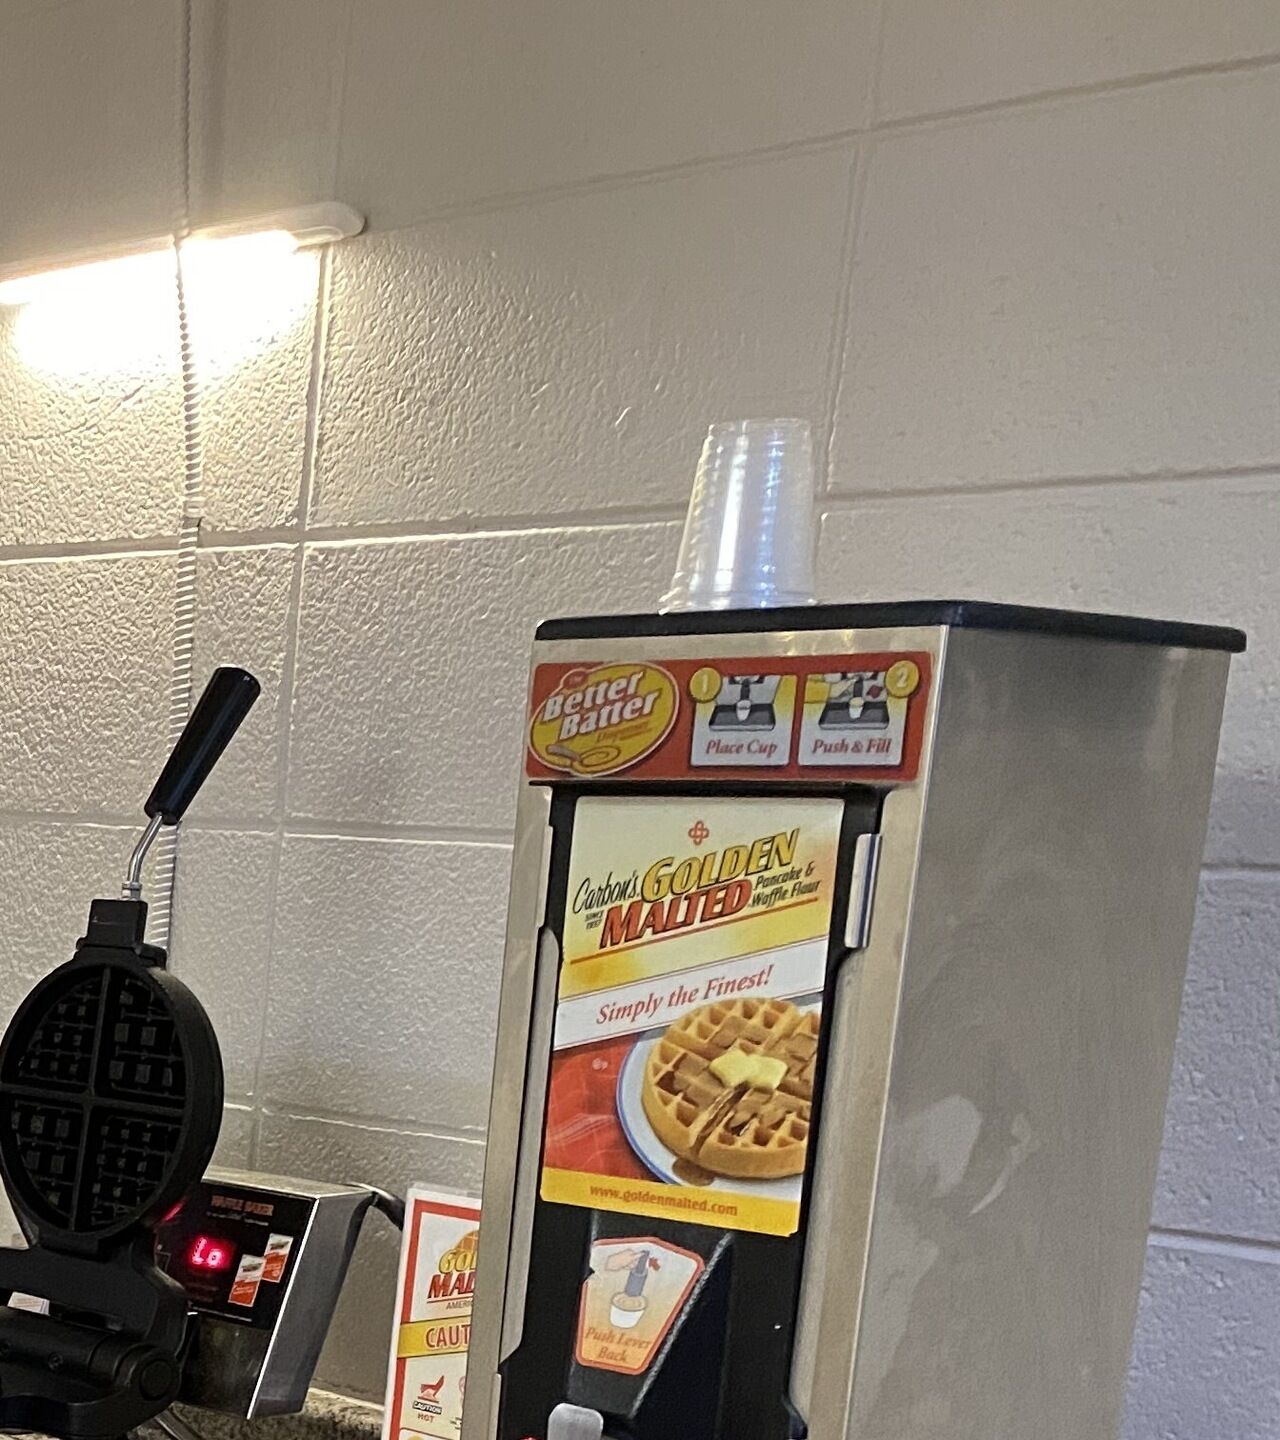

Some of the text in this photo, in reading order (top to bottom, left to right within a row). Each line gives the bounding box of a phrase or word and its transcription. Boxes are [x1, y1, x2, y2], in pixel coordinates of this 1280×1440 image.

[542, 671, 646, 722] Better
[559, 690, 661, 741] Batter
[706, 738, 778, 758] Place Cup
[811, 737, 892, 755] Push & Fill
[640, 828, 801, 903] GOLDEN
[755, 861, 816, 891] Pancake &
[572, 869, 640, 914] Carbon's
[752, 879, 823, 909] Waffle Flour
[598, 878, 754, 950] MALTED
[596, 963, 775, 1025] Simply the Finest!
[590, 1184, 738, 1217] www.goldenmalted.com
[427, 1270, 476, 1300] MAL
[425, 1324, 471, 1348] CAUT
[585, 1326, 653, 1349] Push Lever
[596, 1346, 628, 1363] Back
